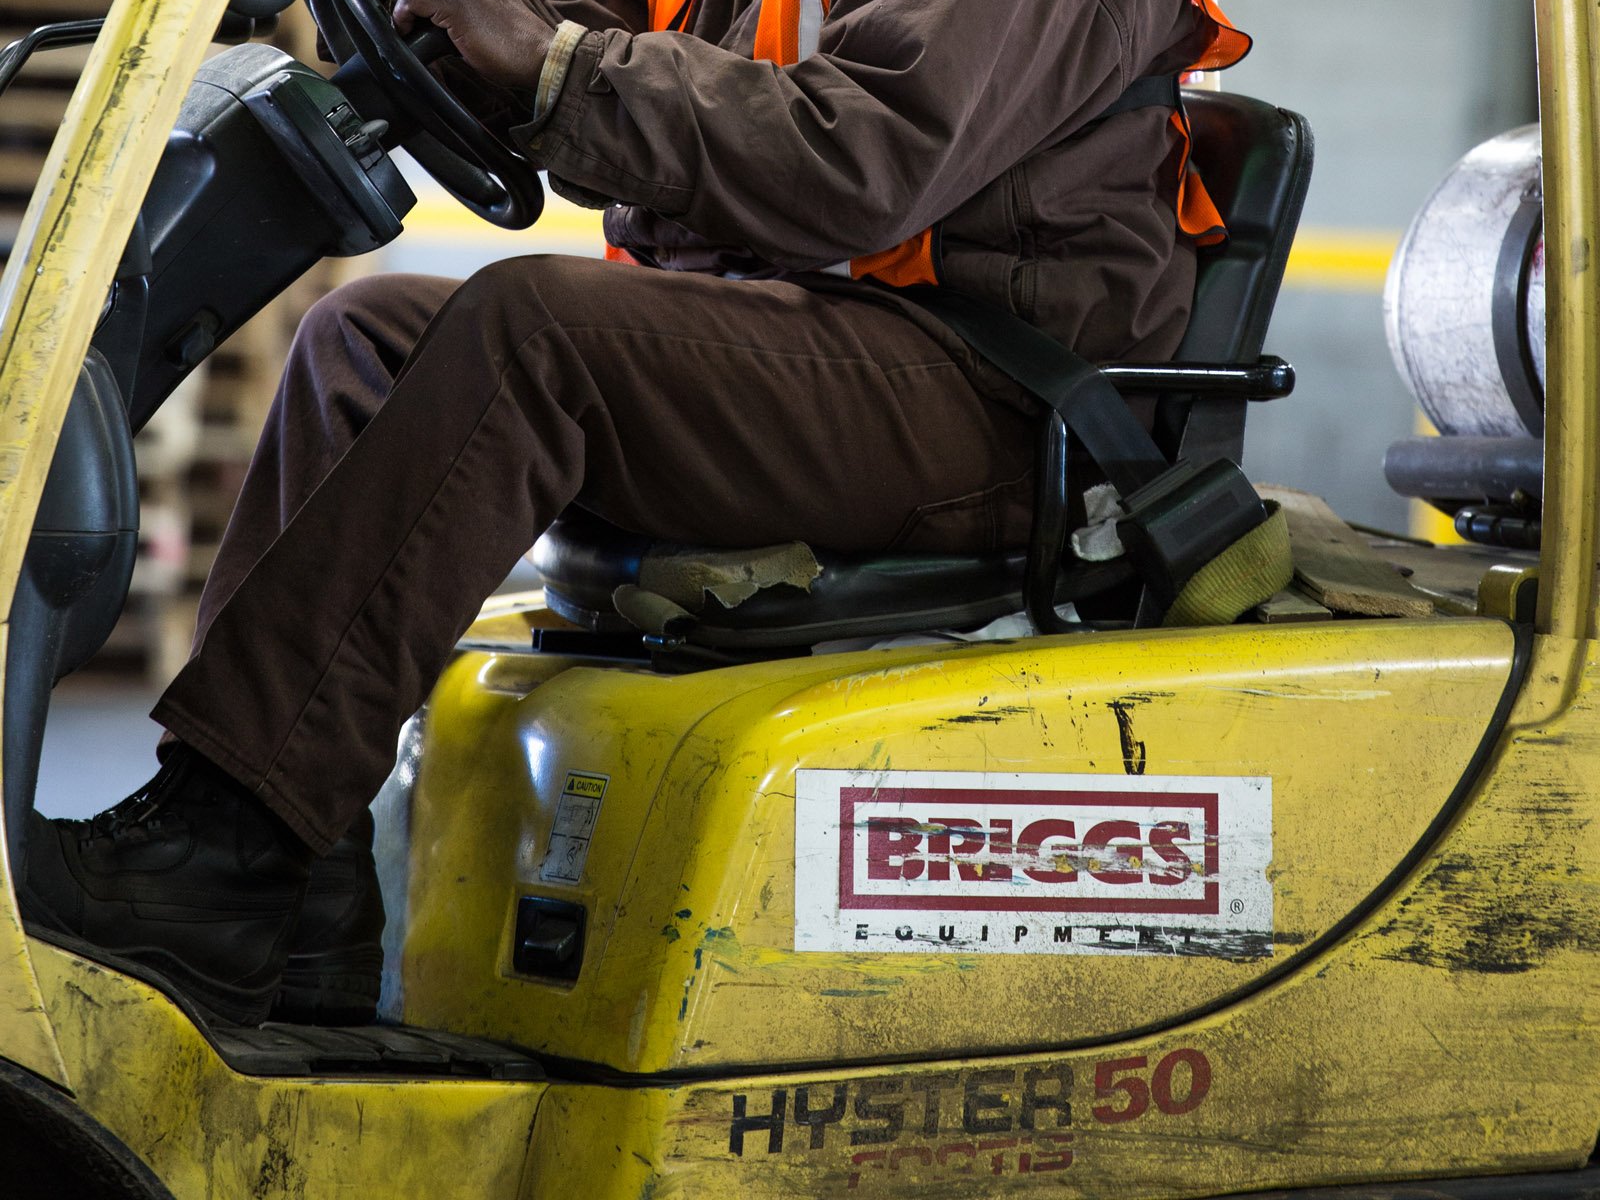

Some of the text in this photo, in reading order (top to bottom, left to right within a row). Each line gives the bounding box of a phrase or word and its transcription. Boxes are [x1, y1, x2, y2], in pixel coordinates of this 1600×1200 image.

[576, 780, 602, 792] CAUTION
[867, 816, 1192, 886] BRIGGS
[855, 924, 1197, 945] EQUIPMENT
[729, 1048, 1211, 1157] HYSTER 50
